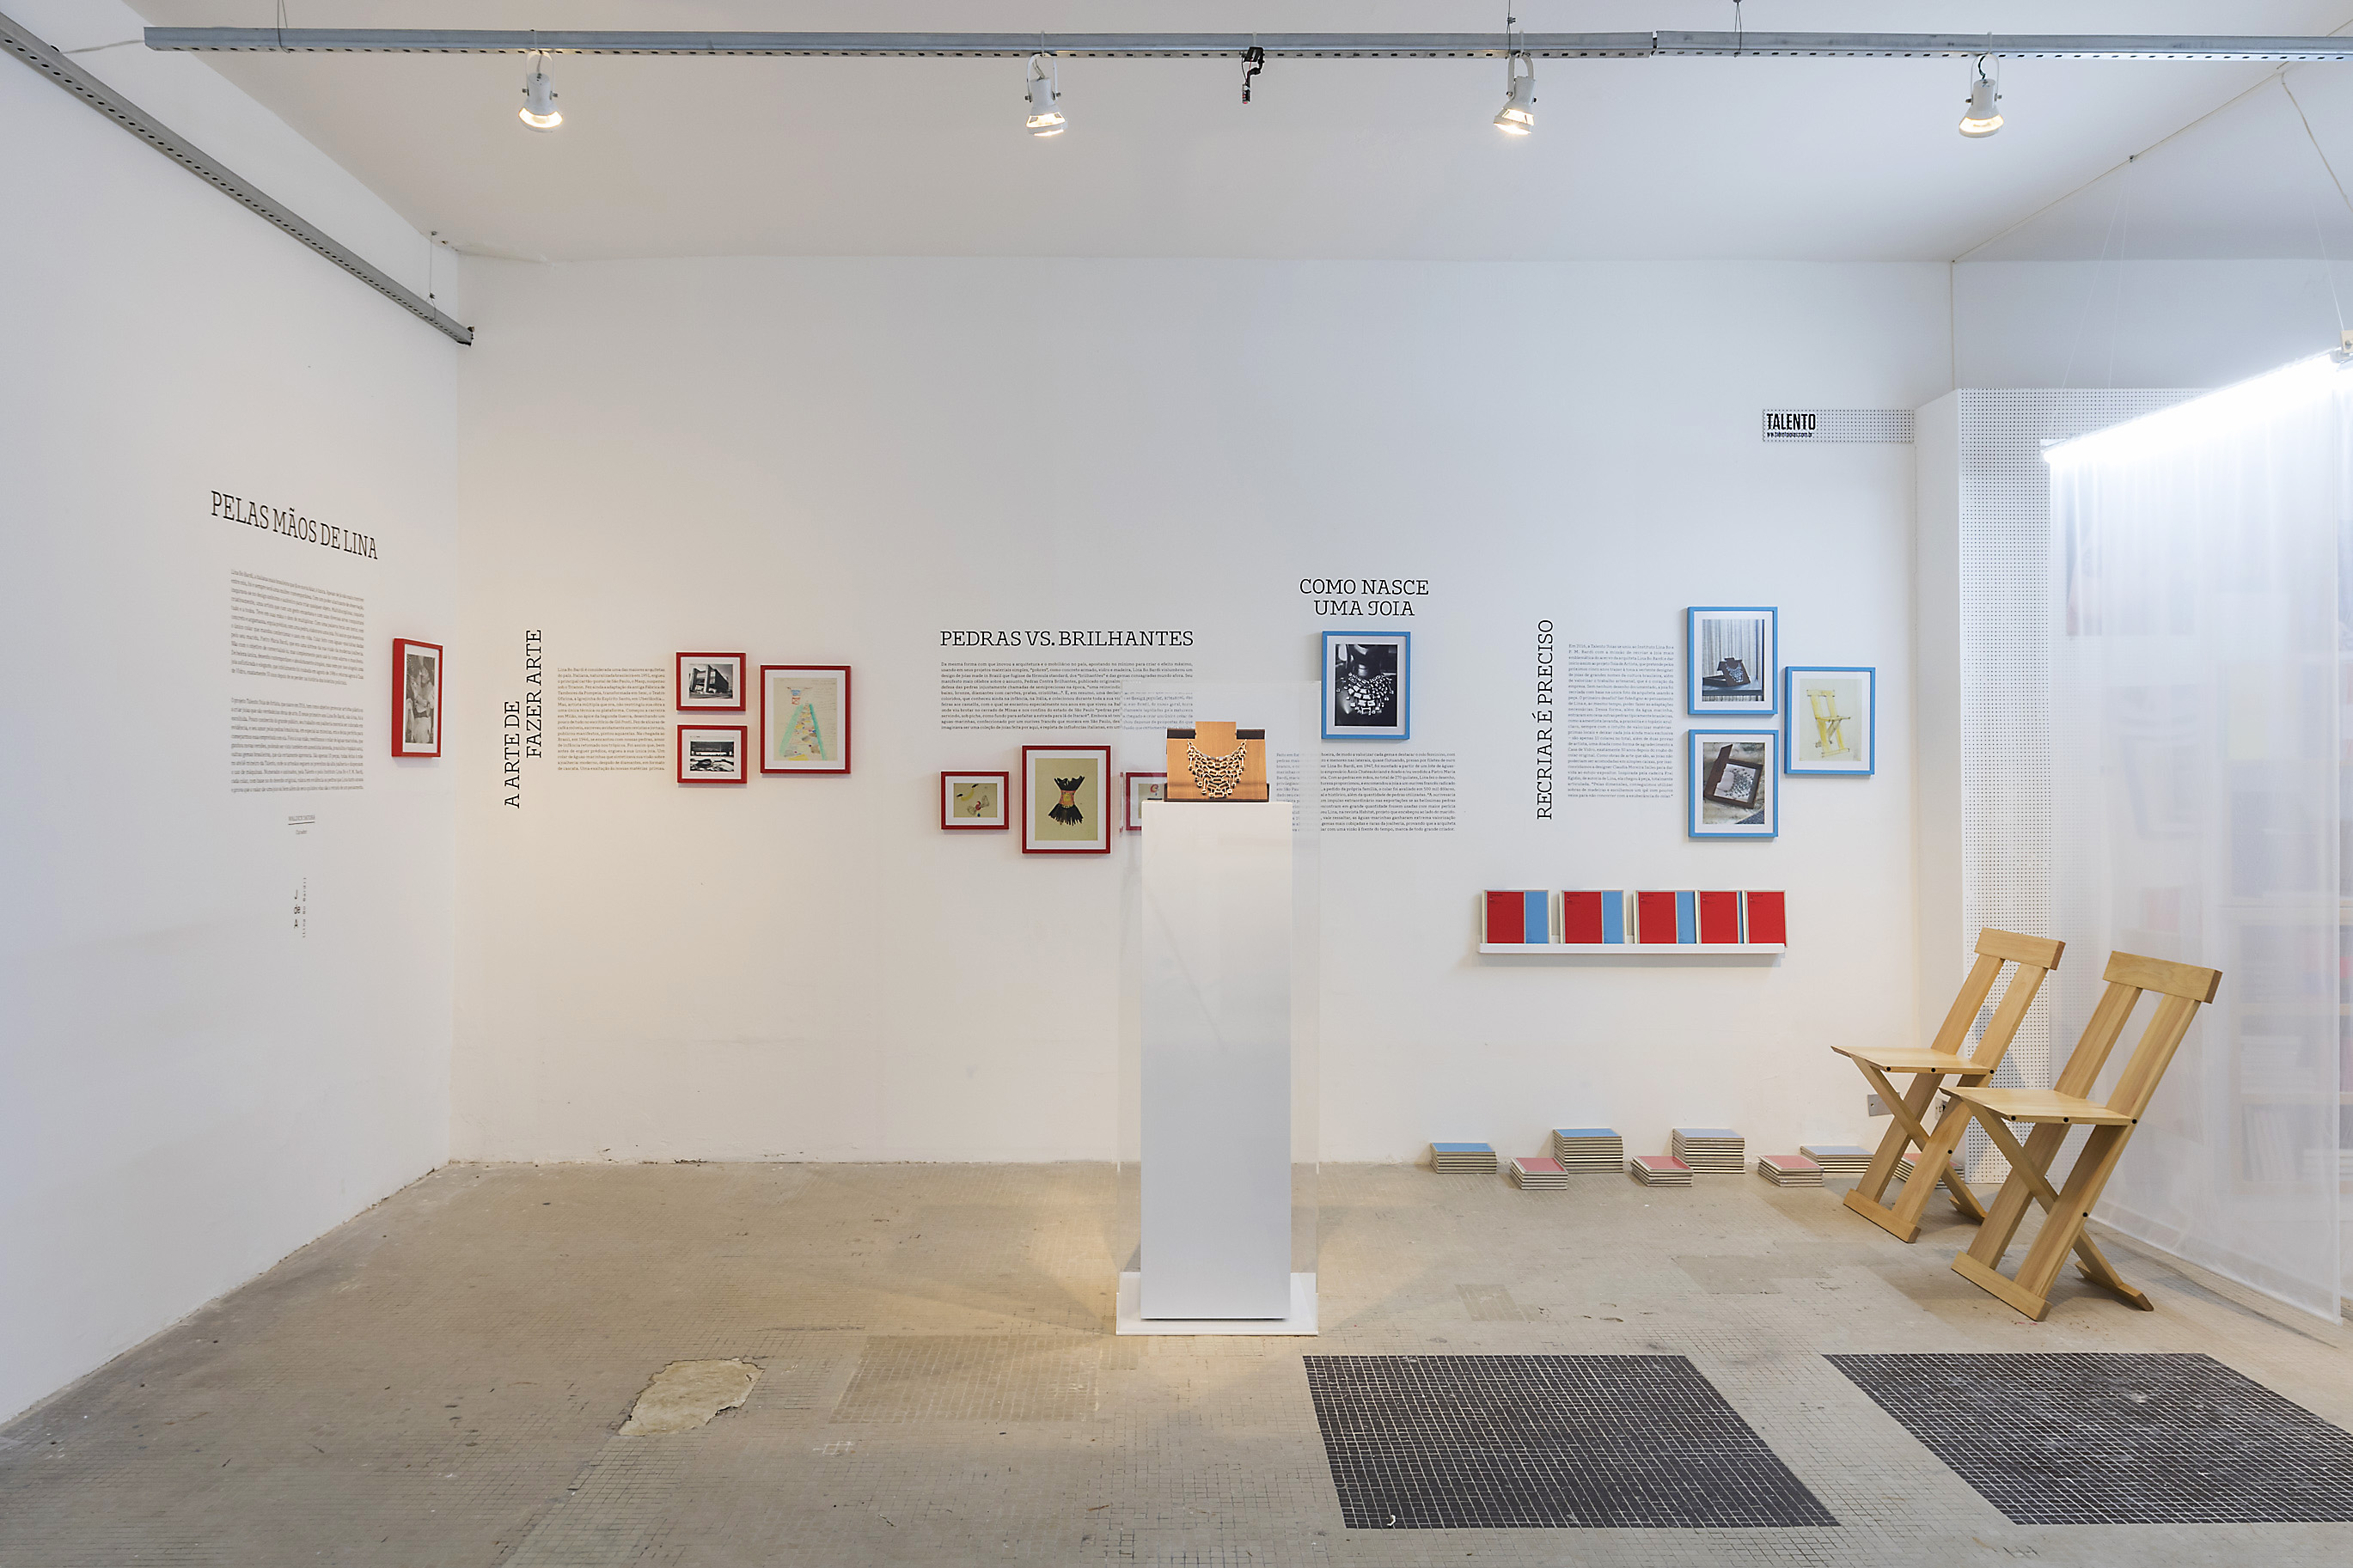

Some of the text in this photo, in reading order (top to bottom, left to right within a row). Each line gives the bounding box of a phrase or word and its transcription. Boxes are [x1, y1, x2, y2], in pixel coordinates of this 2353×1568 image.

[1765, 412, 1816, 430] TALENTO
[211, 490, 378, 560] PELAS MÃOS DE LINA
[1299, 578, 1429, 595] COMO NASCE
[1313, 600, 1415, 616] UMA JOIA
[939, 631, 1194, 647] PEDRAS VS. BRILHANTES
[525, 629, 542, 759] FAZER ARTE
[1532, 619, 1554, 821] RECRIAR É PRECISO
[504, 700, 520, 809] A ARTE DE
